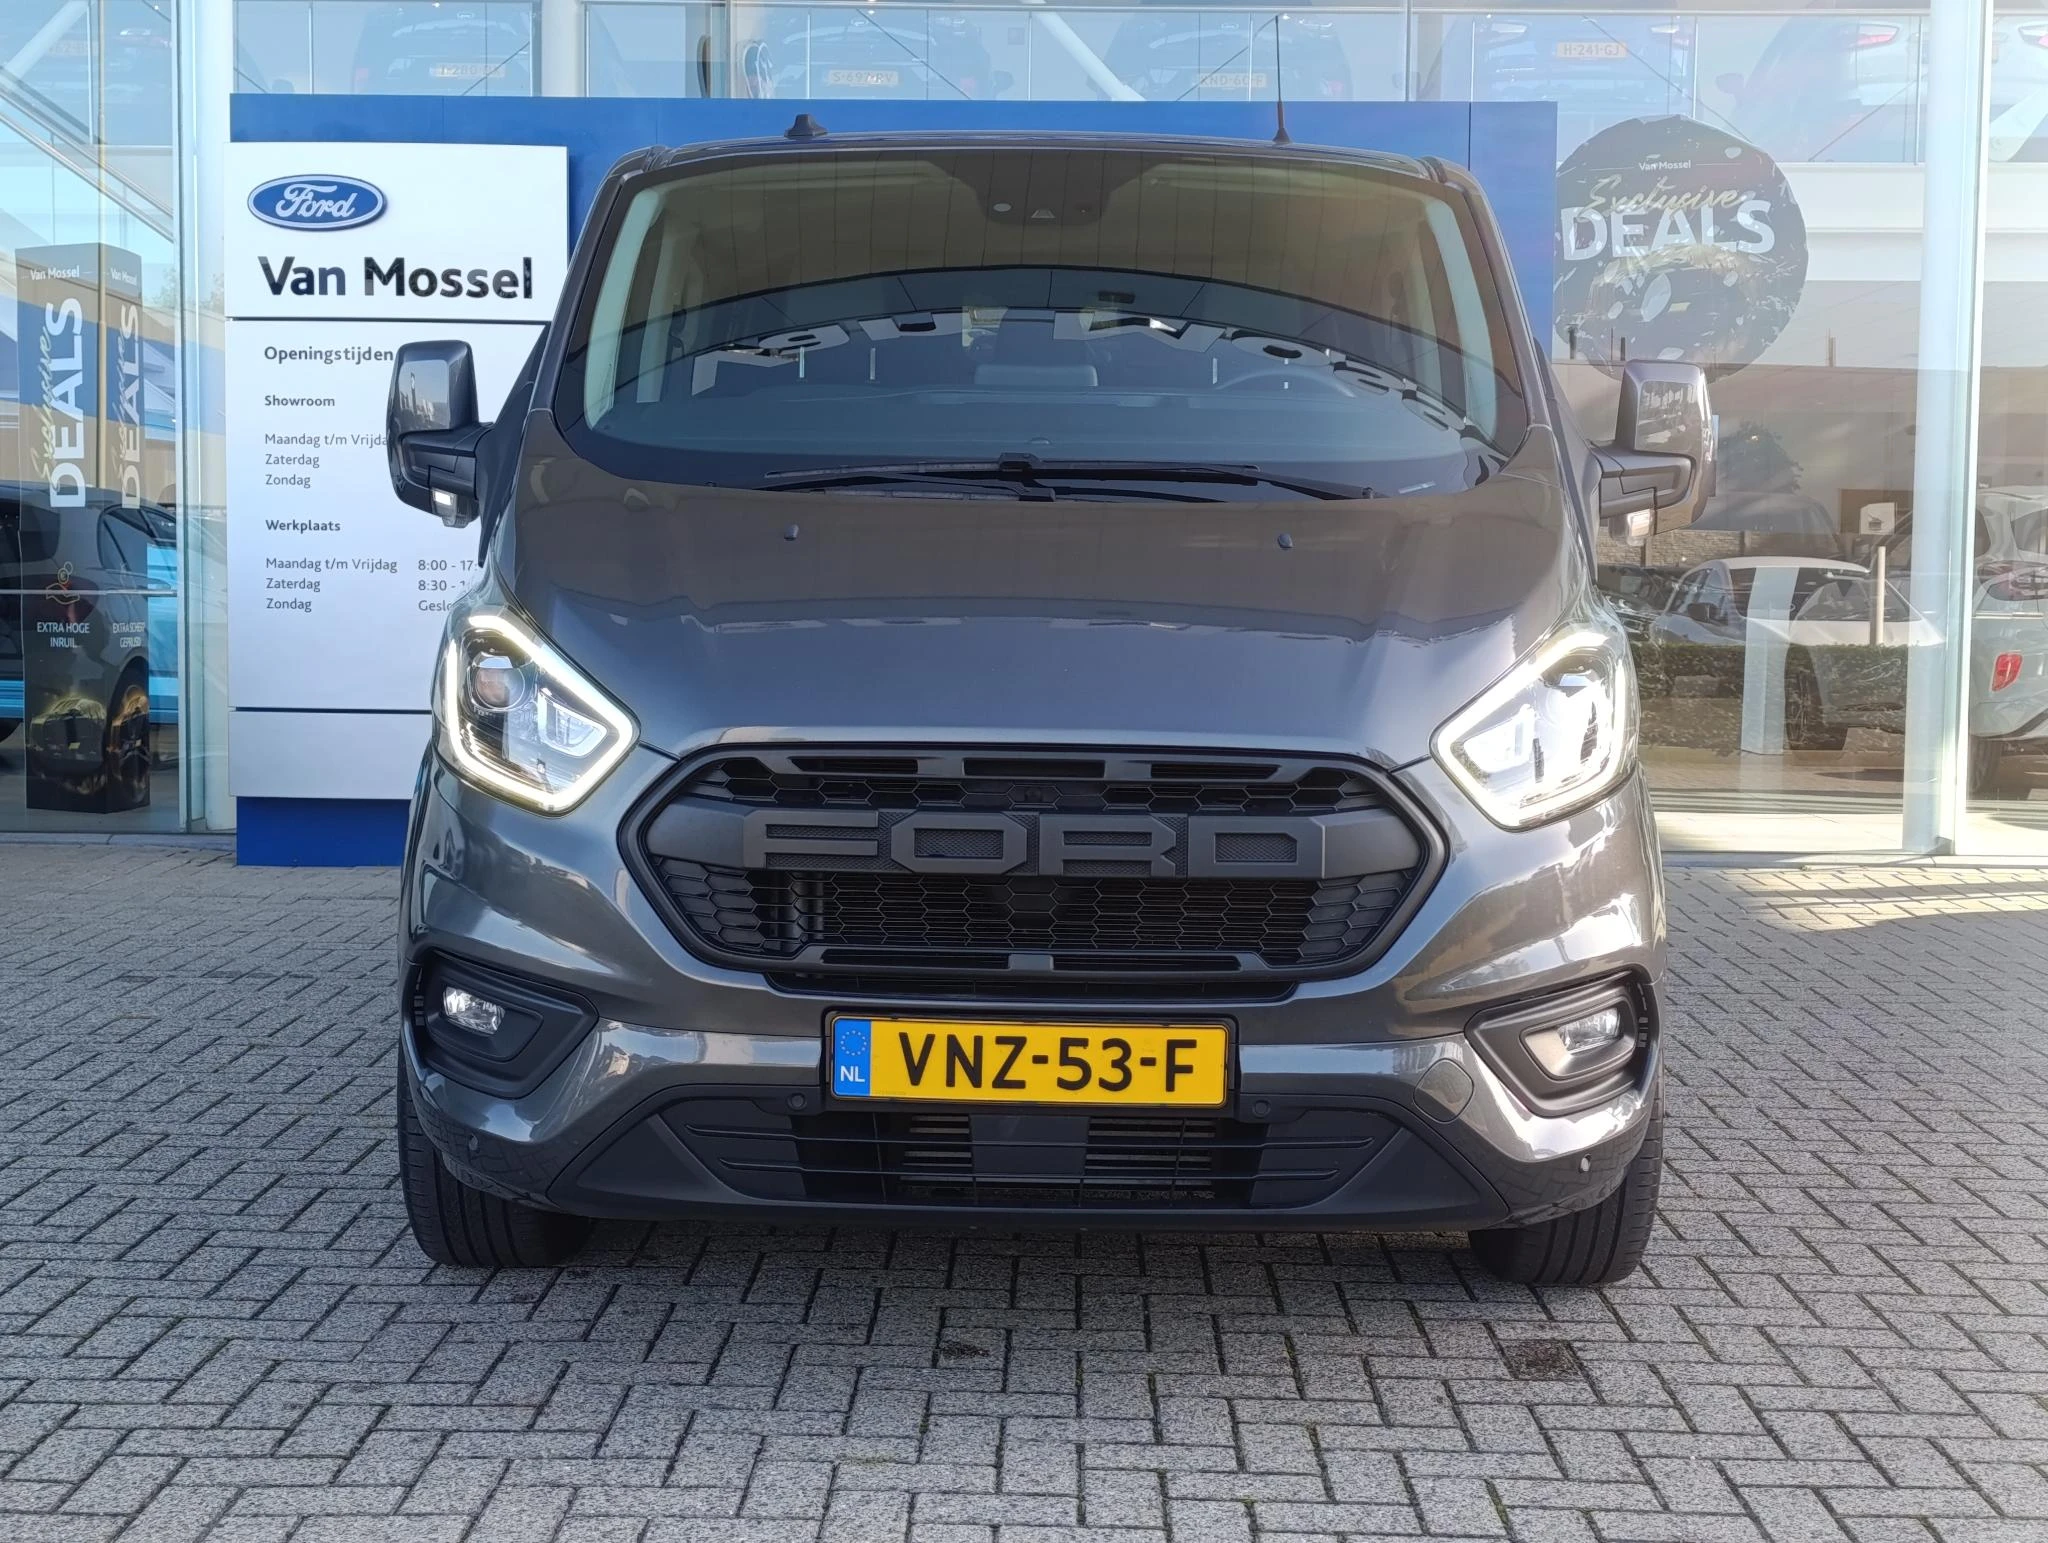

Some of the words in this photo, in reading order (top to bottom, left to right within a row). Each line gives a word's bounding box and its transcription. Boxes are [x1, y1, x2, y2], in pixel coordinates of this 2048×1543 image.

[1639, 161, 1659, 172] Van
[1659, 160, 1692, 170] Mossel
[275, 183, 358, 218] Ford
[1560, 199, 1776, 261] DEALS
[30, 268, 46, 281] Van
[47, 265, 80, 280] Mossel
[257, 256, 346, 296] Van
[364, 256, 532, 299] Mossel
[264, 346, 394, 365] Openingstijden
[45, 297, 86, 508] DEALS
[121, 304, 141, 509] DEALS
[264, 395, 335, 407] Showroom
[265, 433, 321, 448] Maandag
[324, 433, 347, 446] t/m
[265, 453, 320, 469] Zaterdag
[265, 474, 311, 489] Zondag
[265, 520, 341, 534] Werkplaats
[265, 557, 322, 572] Maandag
[325, 558, 348, 571] t/m
[352, 558, 398, 573] Vrijdag
[418, 559, 447, 571] 8:00
[265, 578, 321, 592] Zaterdag
[418, 579, 447, 591] 8:30
[265, 598, 312, 613] Zondag
[36, 621, 66, 634] EXTRA
[66, 622, 91, 634] HOGE
[49, 637, 78, 648] INRUIL
[744, 808, 1322, 880] FORD
[898, 1031, 1198, 1093] VNZ-53-F
[840, 1065, 866, 1083] NL
